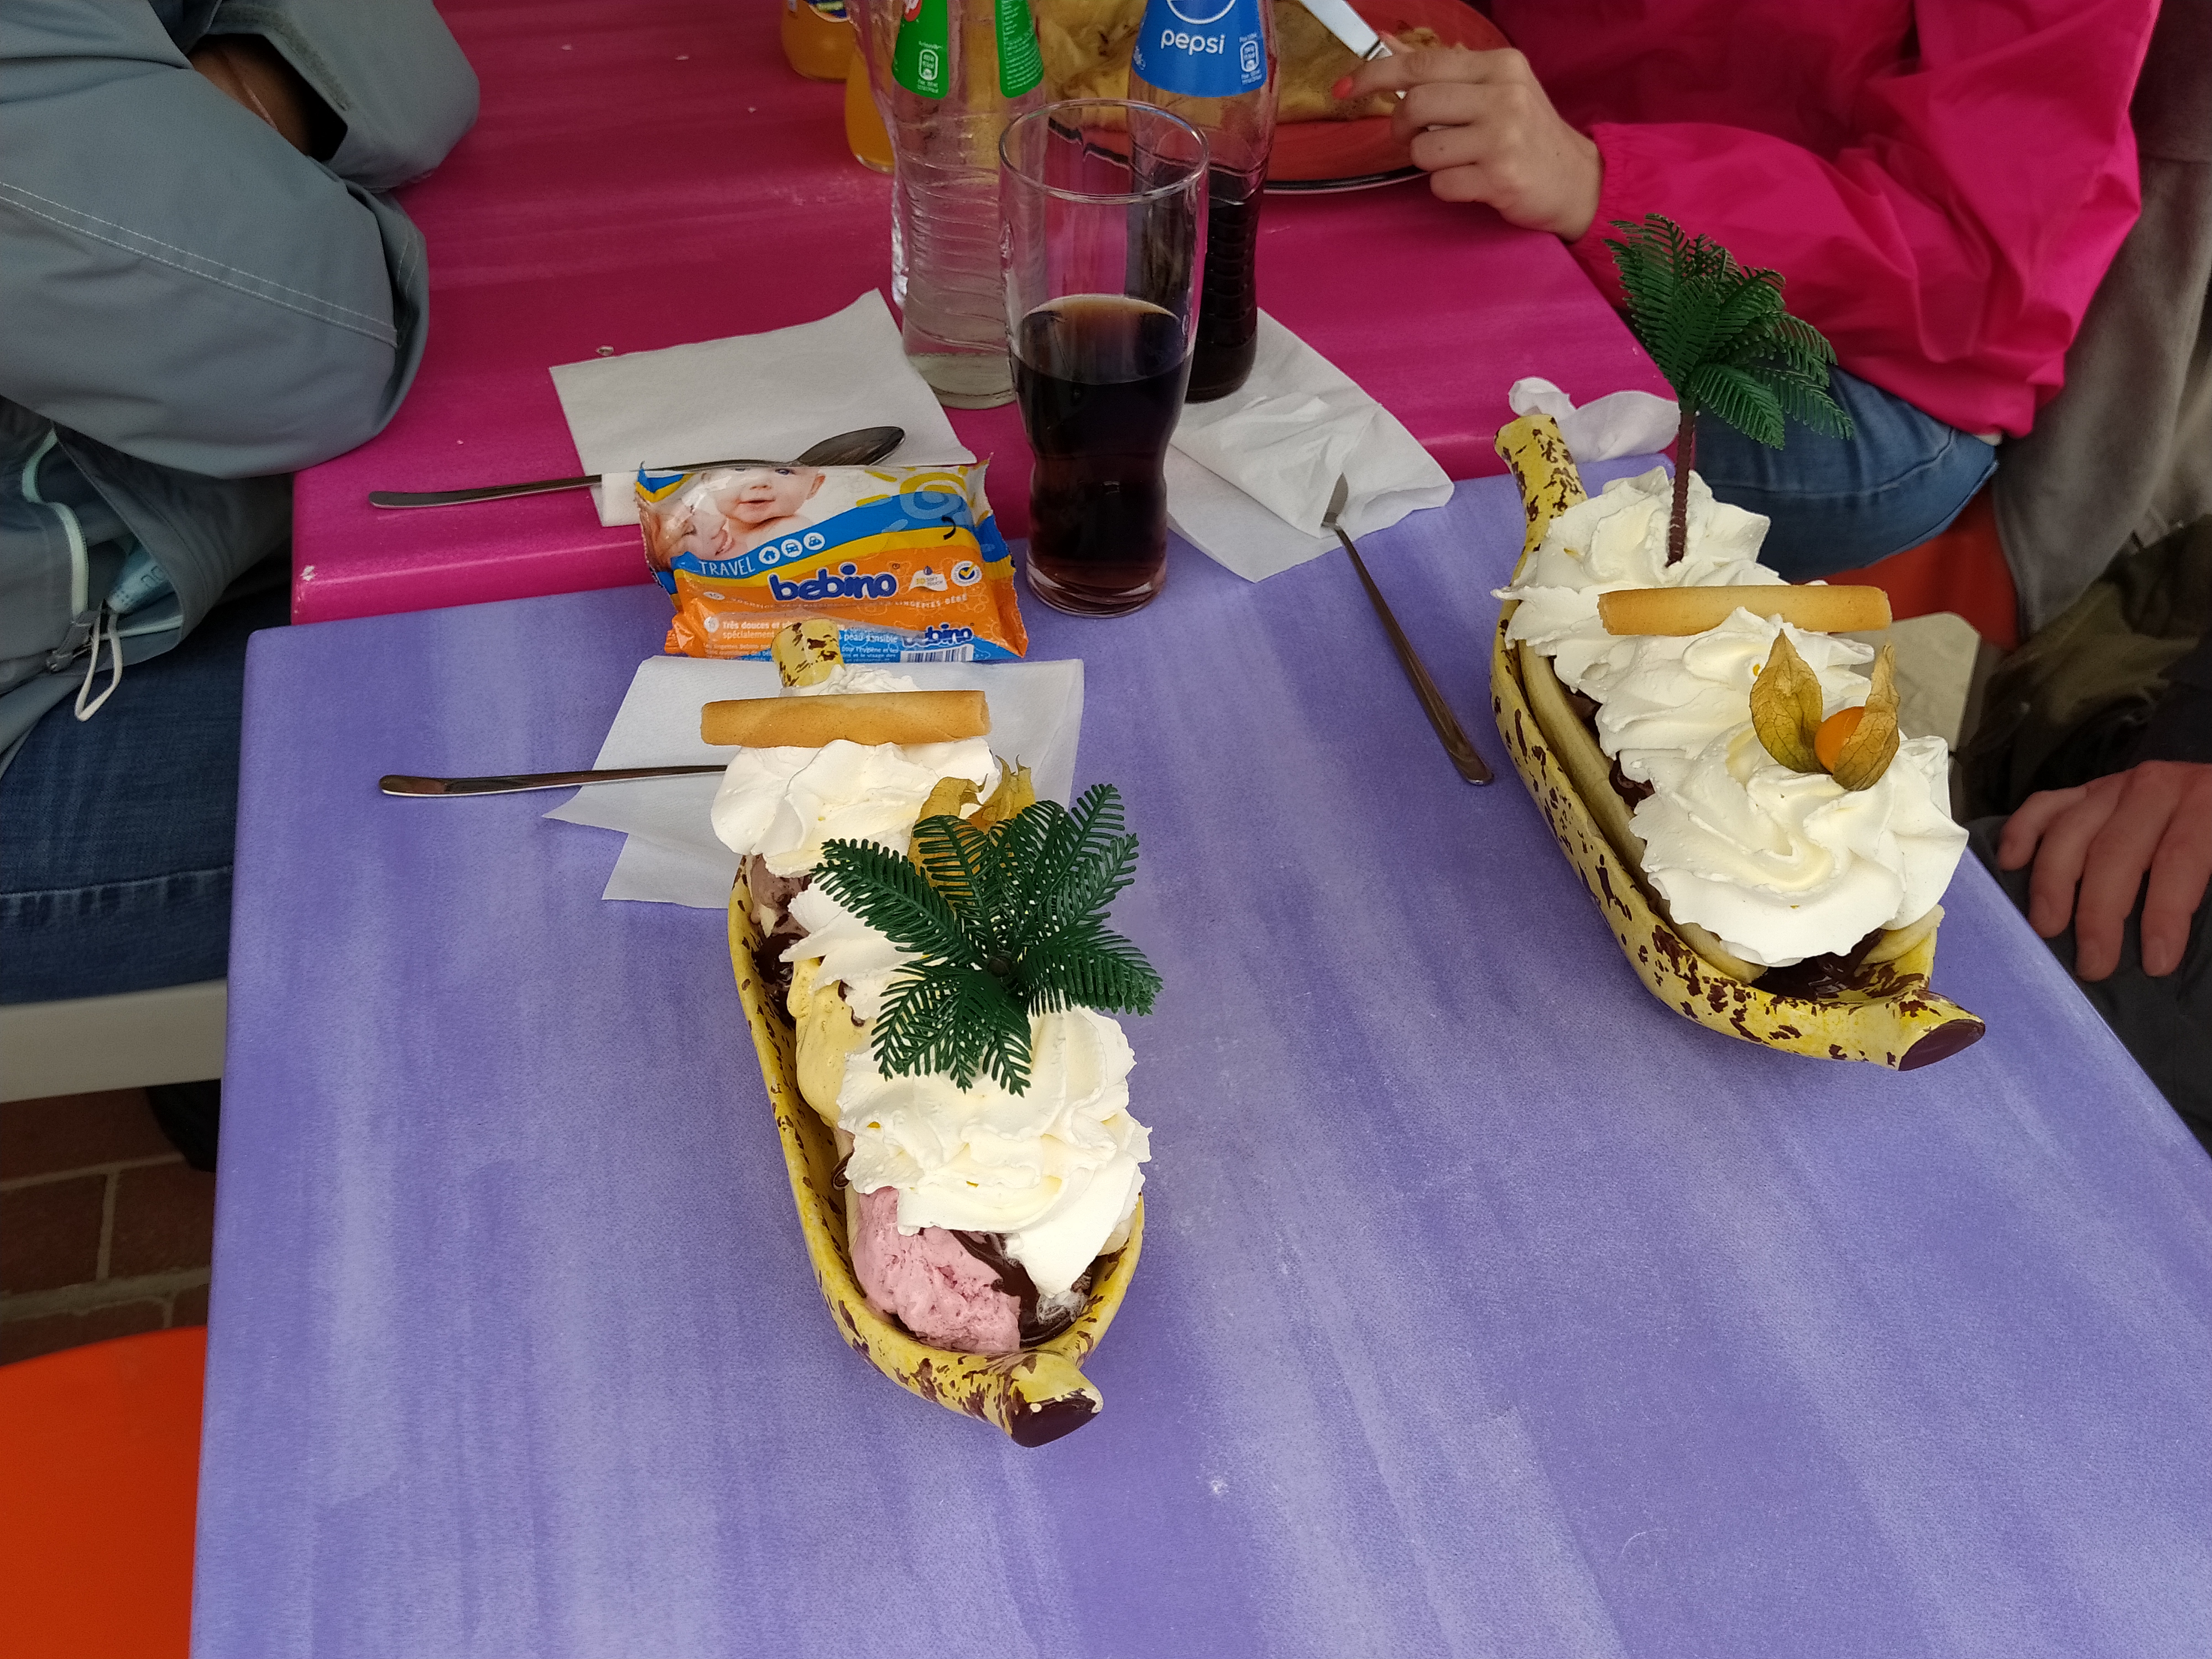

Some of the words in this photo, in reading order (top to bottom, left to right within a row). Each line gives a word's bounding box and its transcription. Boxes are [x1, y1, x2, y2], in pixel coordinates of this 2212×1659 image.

[1160, 29, 1225, 56] pepsi
[699, 556, 756, 576] TRAVEL
[768, 561, 899, 602] bebino
[722, 620, 739, 629] Très
[741, 621, 770, 629] douces
[722, 630, 774, 640] spécialement
[865, 634, 898, 643] sensible
